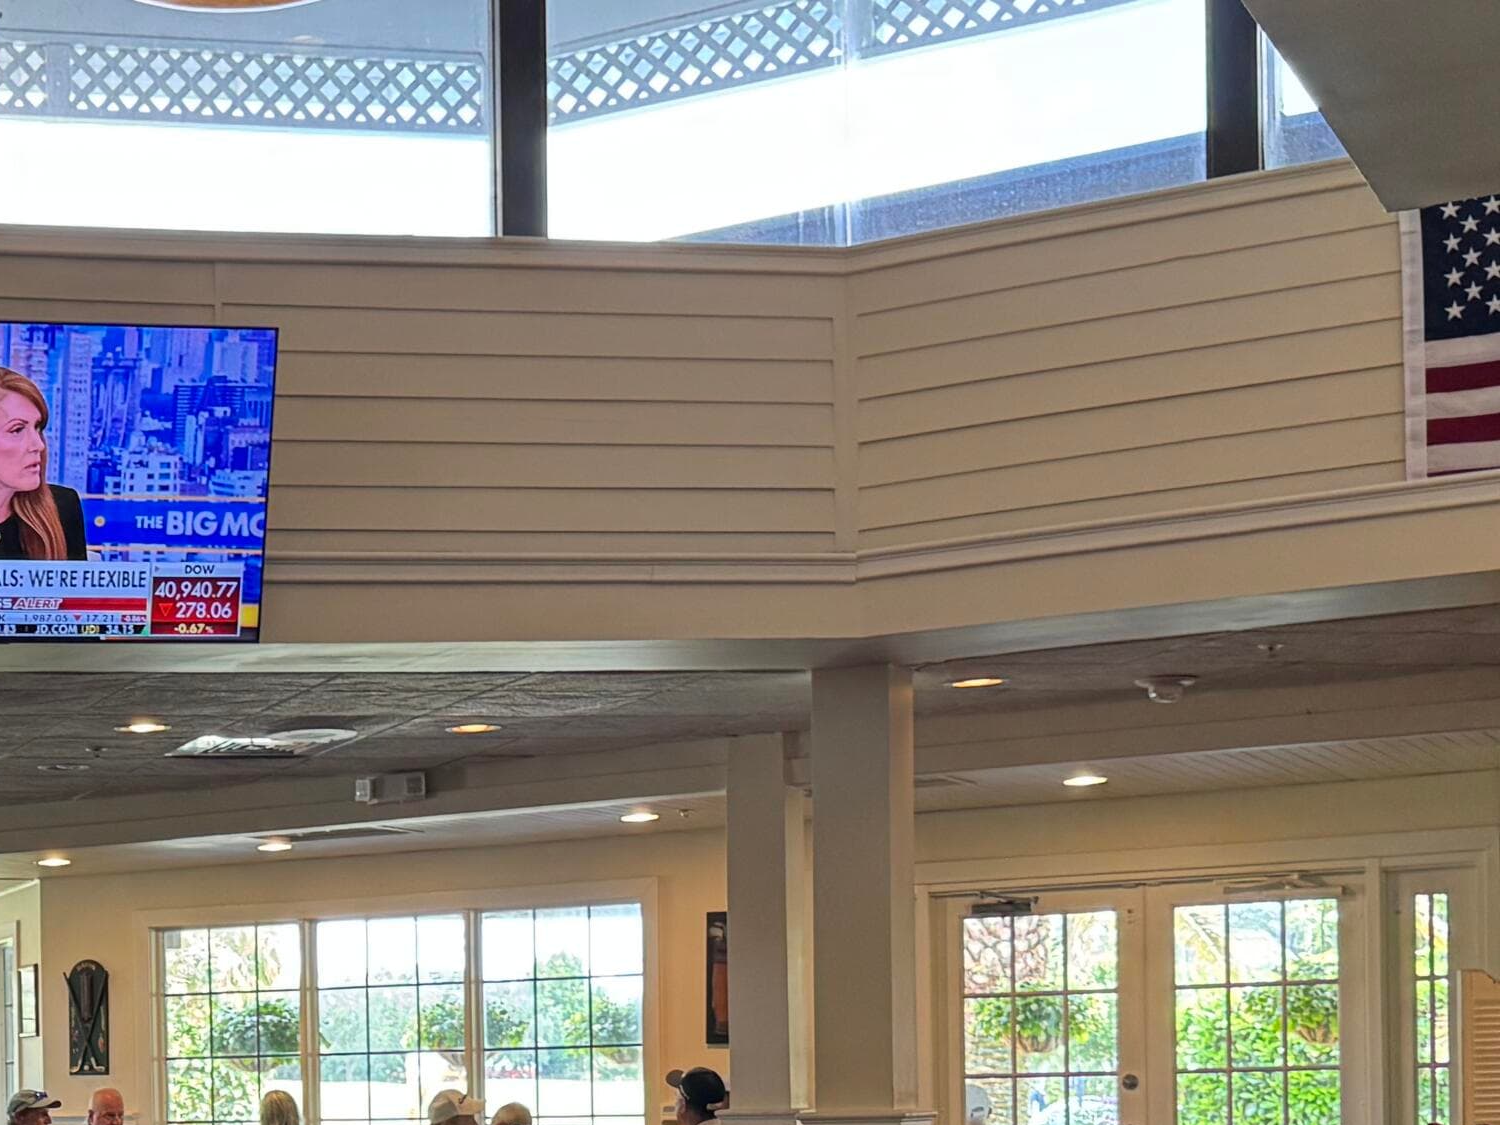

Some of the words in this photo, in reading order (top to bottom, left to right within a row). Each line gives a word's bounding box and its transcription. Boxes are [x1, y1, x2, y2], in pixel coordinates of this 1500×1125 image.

[135, 516, 163, 529] THE
[166, 511, 218, 536] BIG
[184, 565, 215, 575] DOW
[29, 570, 78, 588] WE'RE
[83, 571, 146, 588] FLEXIBLE
[154, 581, 238, 600] 40,940.77
[12, 598, 63, 609] ALERT
[176, 602, 232, 619] 278.06
[174, 623, 214, 634] -0.67%
